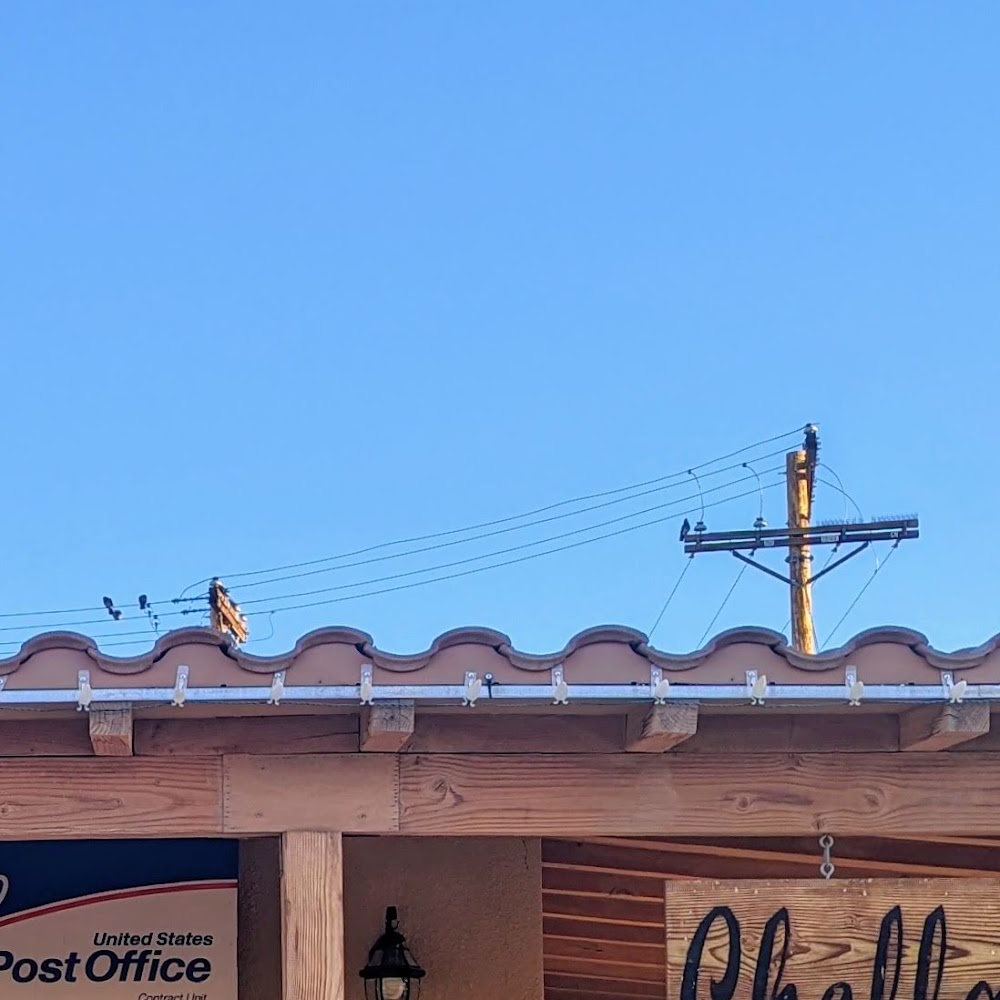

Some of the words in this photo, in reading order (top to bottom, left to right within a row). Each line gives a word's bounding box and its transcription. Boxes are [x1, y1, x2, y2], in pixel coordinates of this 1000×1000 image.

[93, 932, 153, 946] United
[156, 932, 214, 946] States
[85, 949, 212, 983] Office
